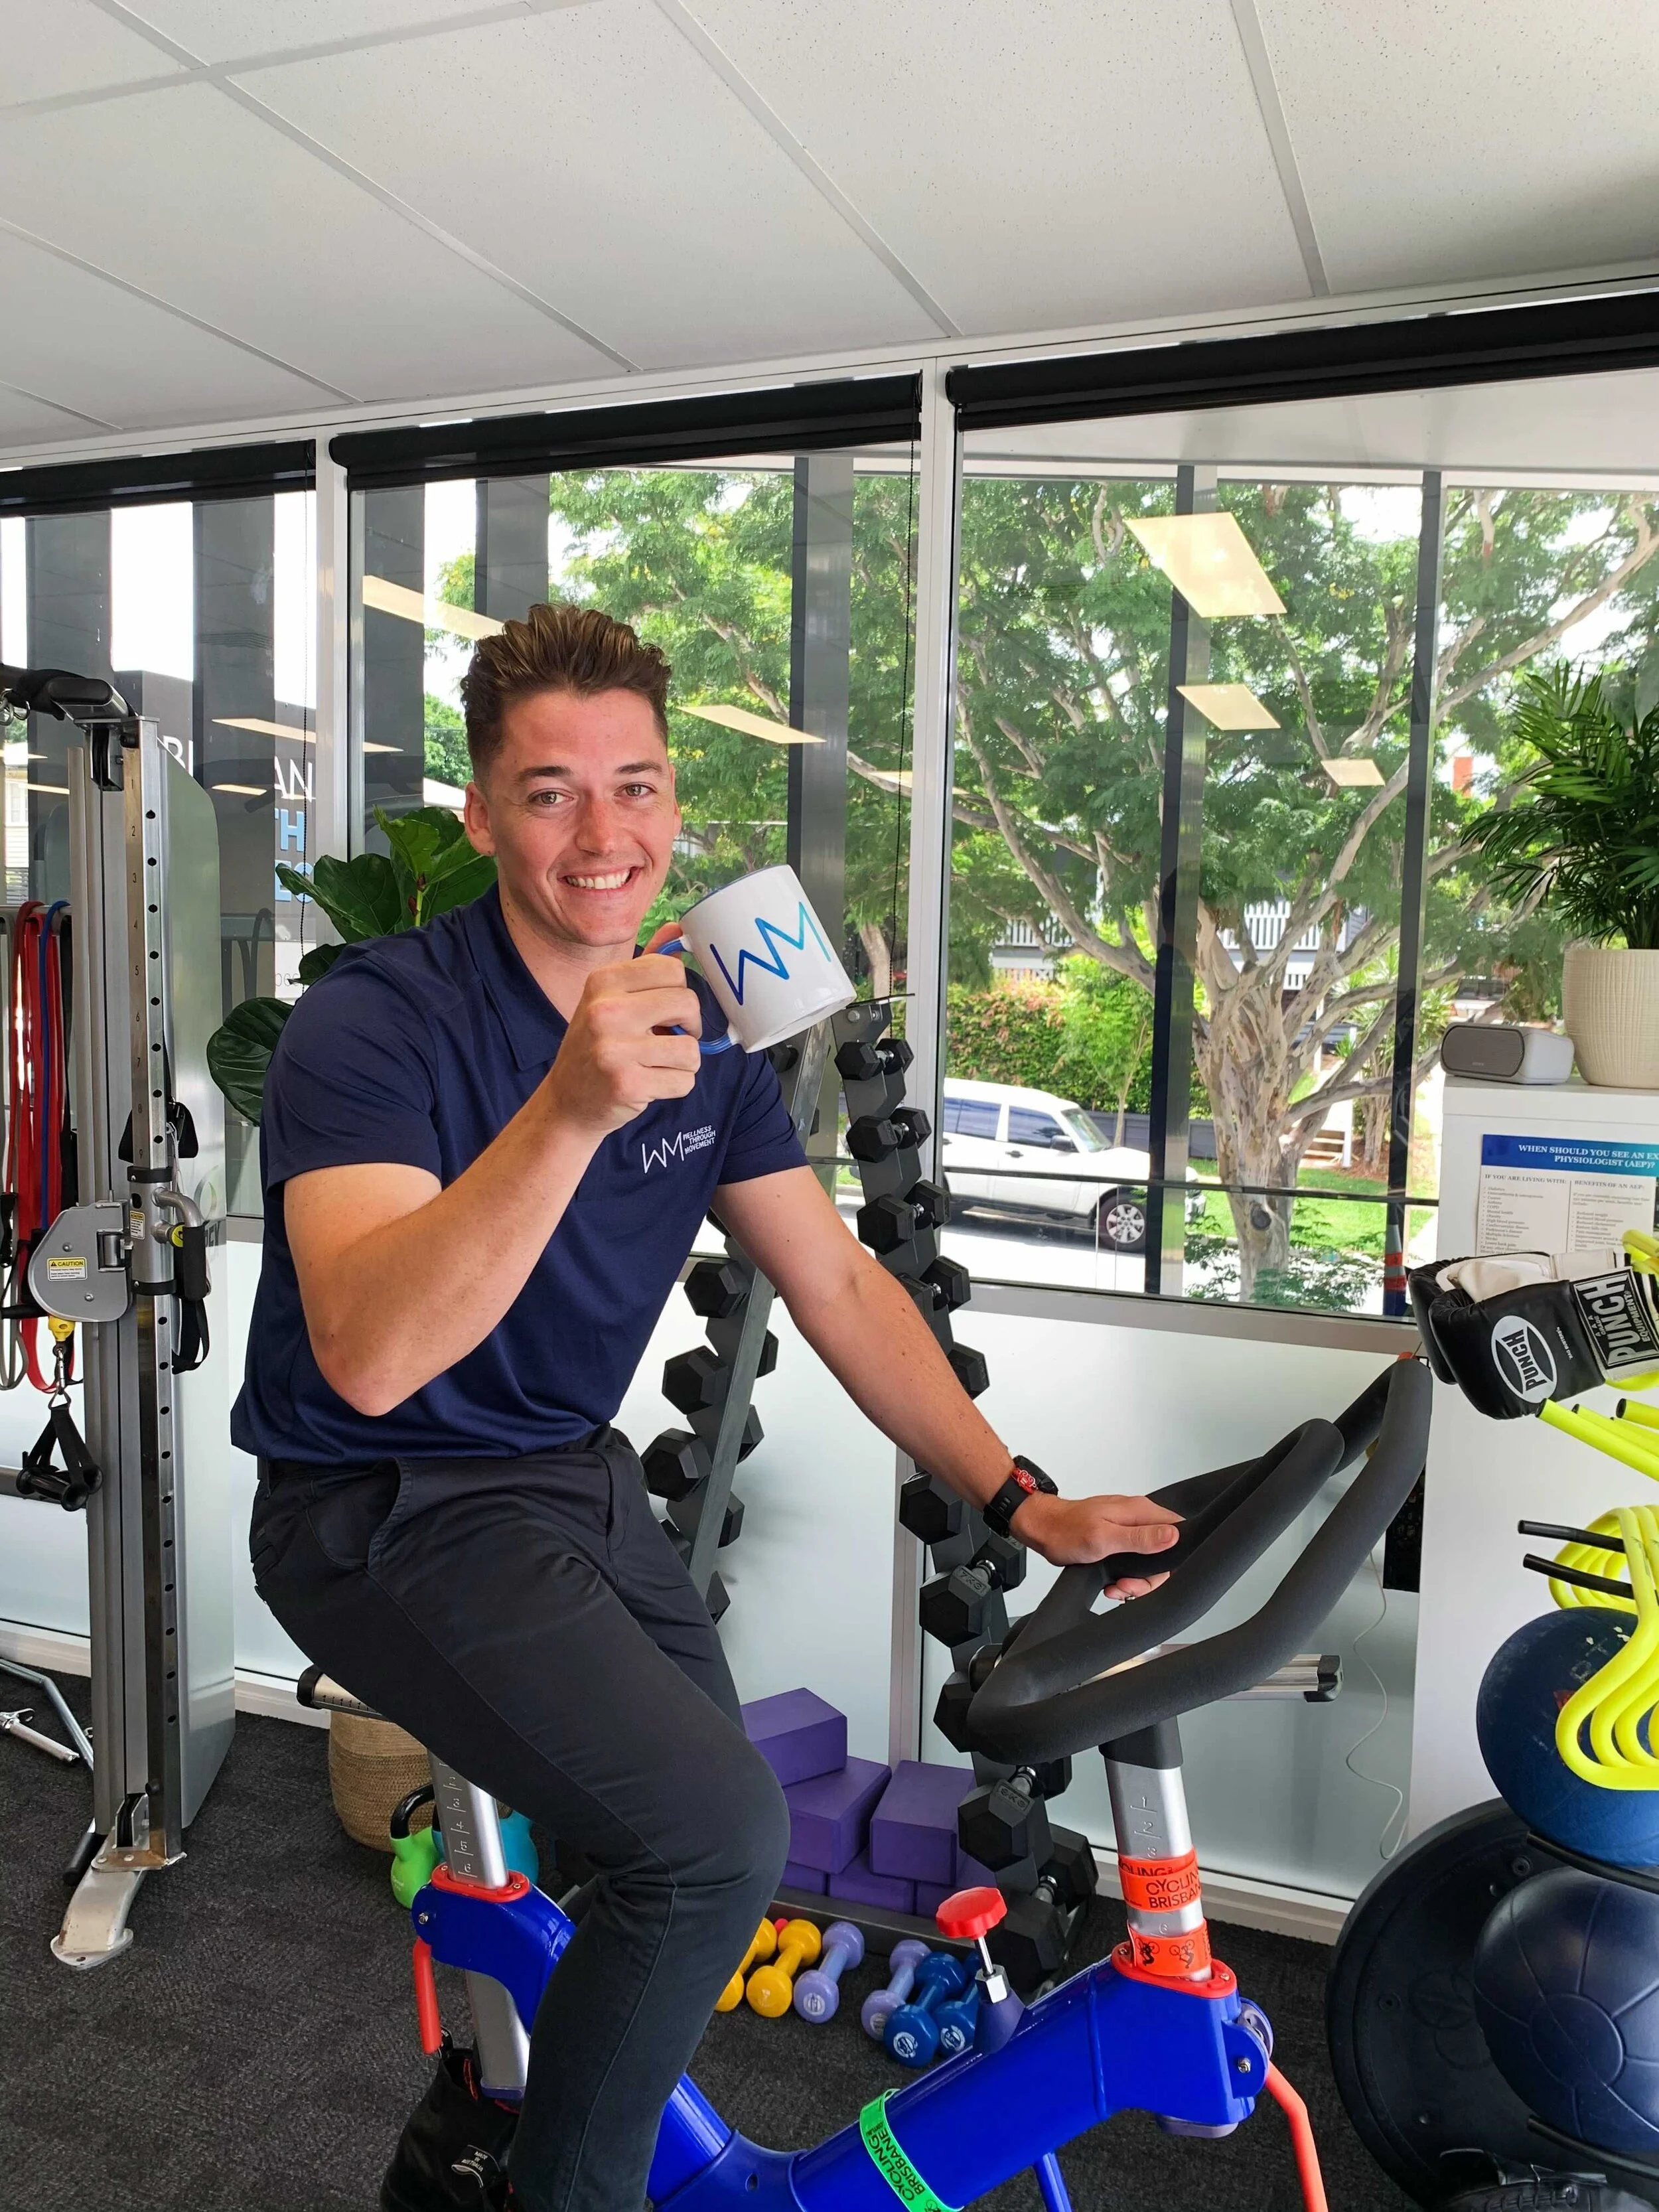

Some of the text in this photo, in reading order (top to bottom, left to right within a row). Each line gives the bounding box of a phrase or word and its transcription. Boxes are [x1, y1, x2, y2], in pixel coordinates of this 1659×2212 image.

[131, 826, 136, 837] 2
[132, 873, 137, 883] 3
[133, 920, 138, 929] 4
[135, 965, 139, 976] 5
[136, 1011, 140, 1022] 6
[683, 1125, 712, 1141] WELLNESS
[689, 1130, 716, 1145] THROUGH
[684, 1138, 715, 1155] MOVEMENT
[1550, 1147, 1588, 1155] SHOULD
[1555, 1155, 1623, 1166] PHYSIOLOGIST
[1577, 1272, 1659, 1366] PUNCH
[1595, 1315, 1606, 1335] GRADE
[1501, 1329, 1548, 1391] PUNCH
[961, 1570, 982, 1590] 7KG
[1141, 1796, 1147, 1808] 1
[456, 1820, 465, 1830] 4
[1143, 1821, 1154, 1833] 2
[461, 1840, 467, 1851] 5
[465, 1863, 471, 1873] 6
[474, 2151, 488, 2161] MADE
[878, 2128, 926, 2195] BRISBANE
[461, 2158, 484, 2173] AUSTRALIA
[869, 2135, 915, 2201] CYCLING
